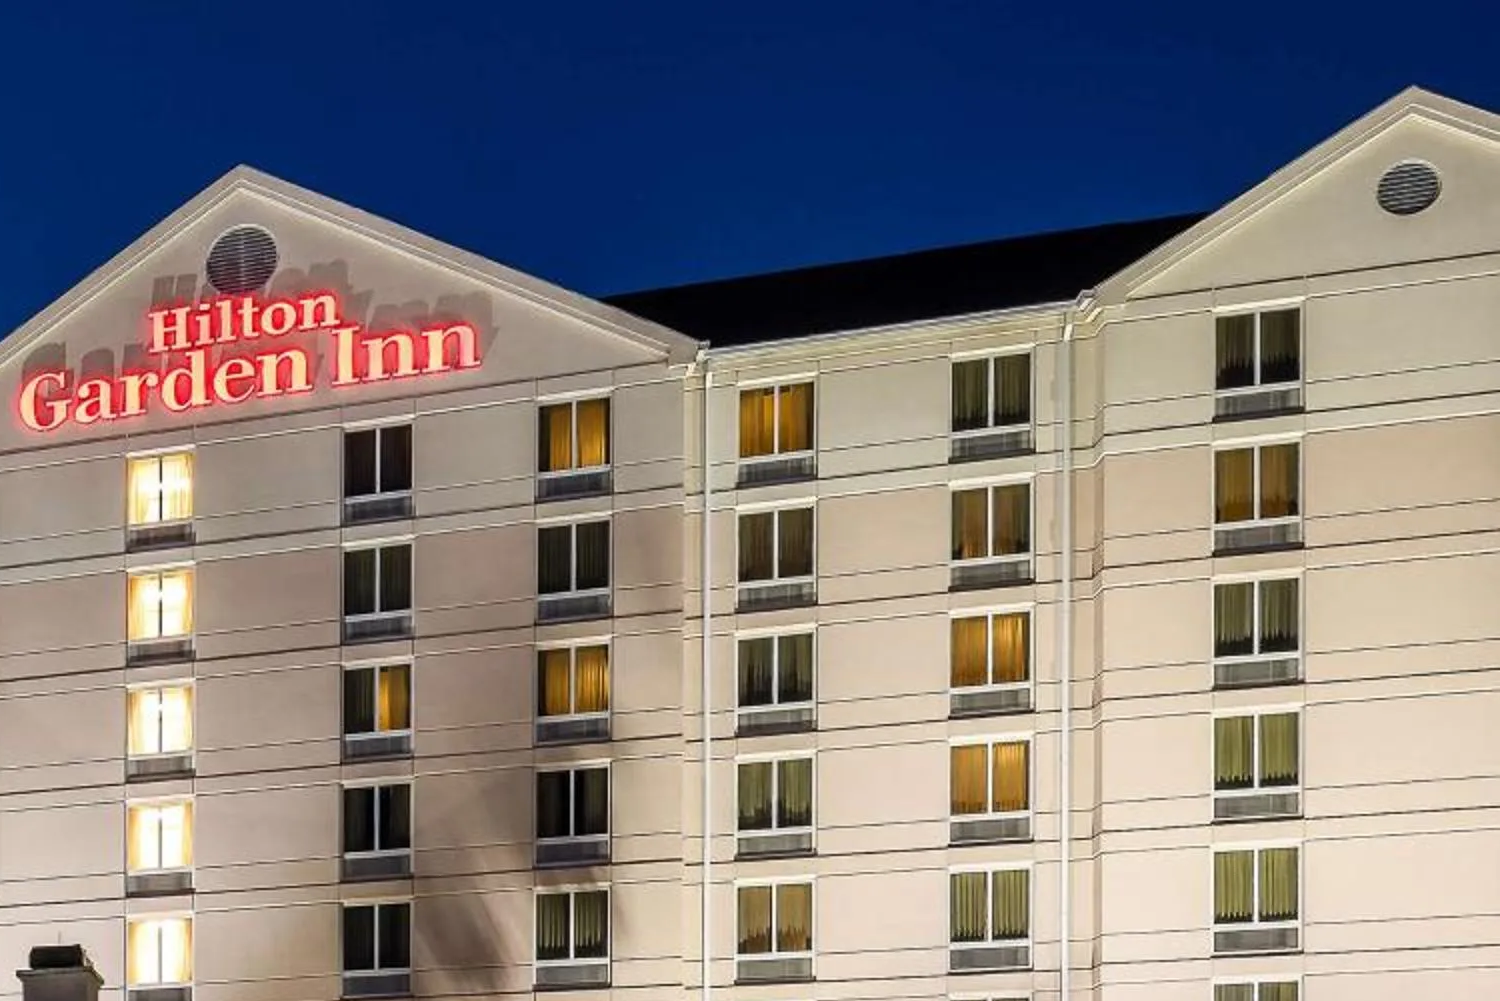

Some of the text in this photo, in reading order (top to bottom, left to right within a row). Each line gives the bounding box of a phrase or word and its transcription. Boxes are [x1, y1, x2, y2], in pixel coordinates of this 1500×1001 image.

[148, 293, 341, 354] Hilton
[18, 324, 482, 432] Garden Inn
